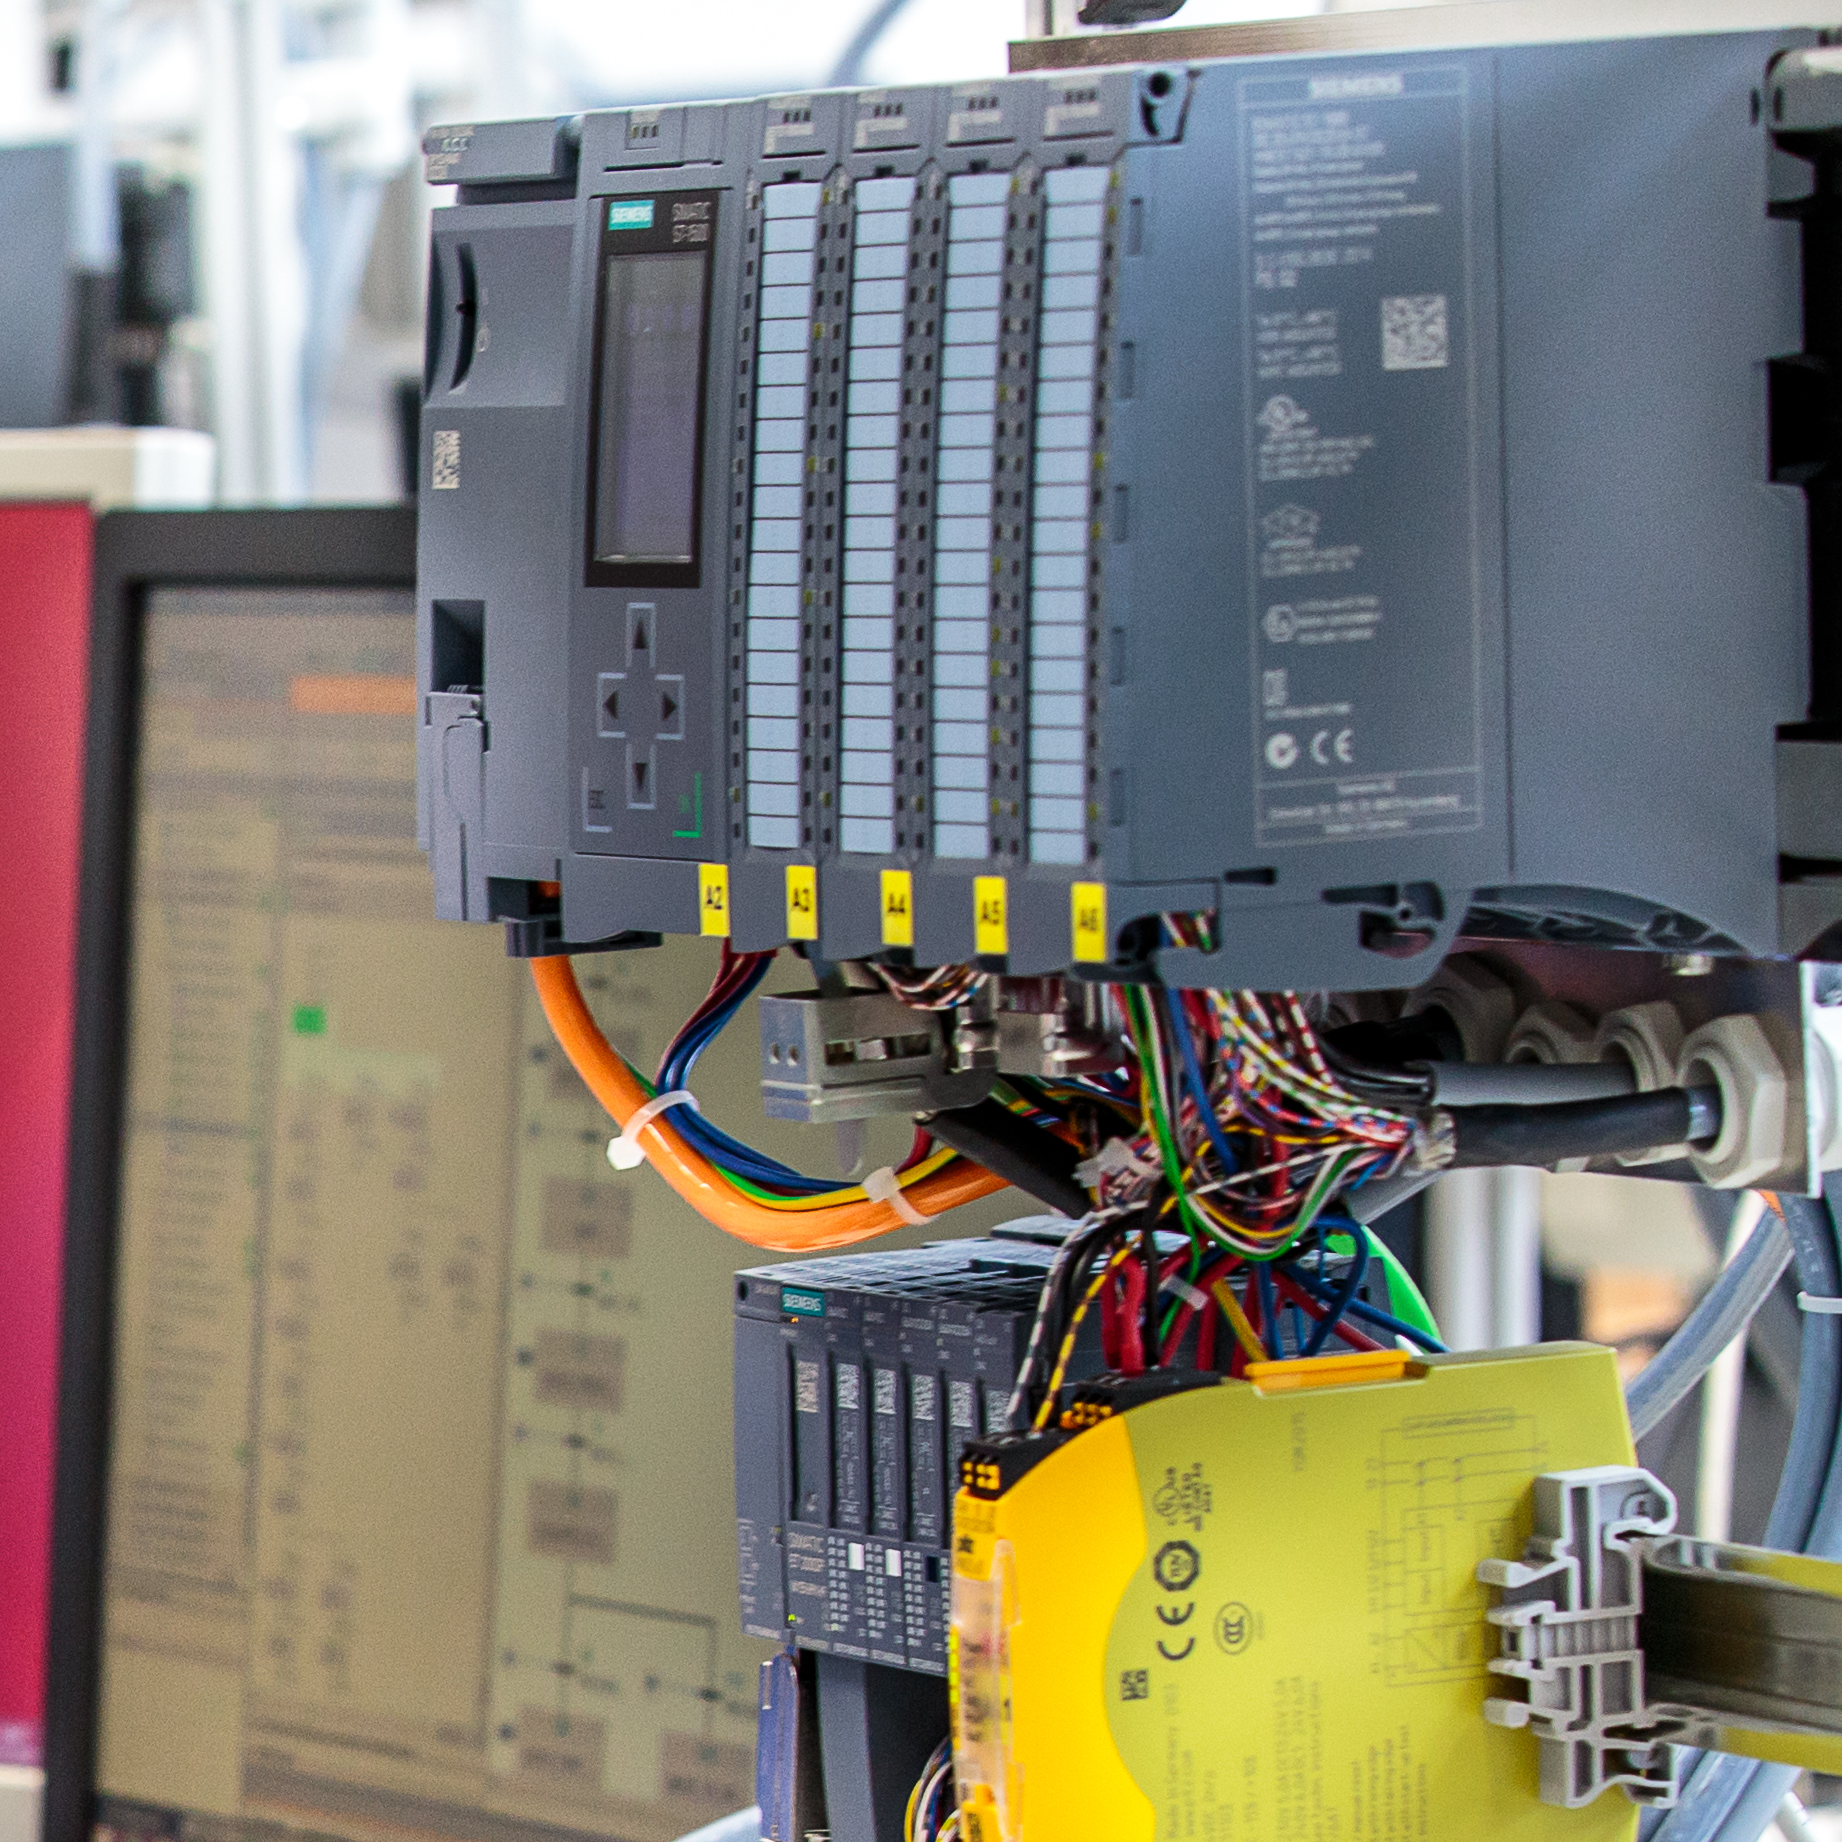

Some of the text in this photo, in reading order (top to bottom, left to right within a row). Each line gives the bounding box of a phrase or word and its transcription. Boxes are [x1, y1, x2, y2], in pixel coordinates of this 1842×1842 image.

[706, 886, 723, 911] A2
[792, 887, 811, 913] A3
[886, 893, 906, 914] A4
[979, 901, 1001, 926] A5
[1078, 906, 1102, 932] A6
